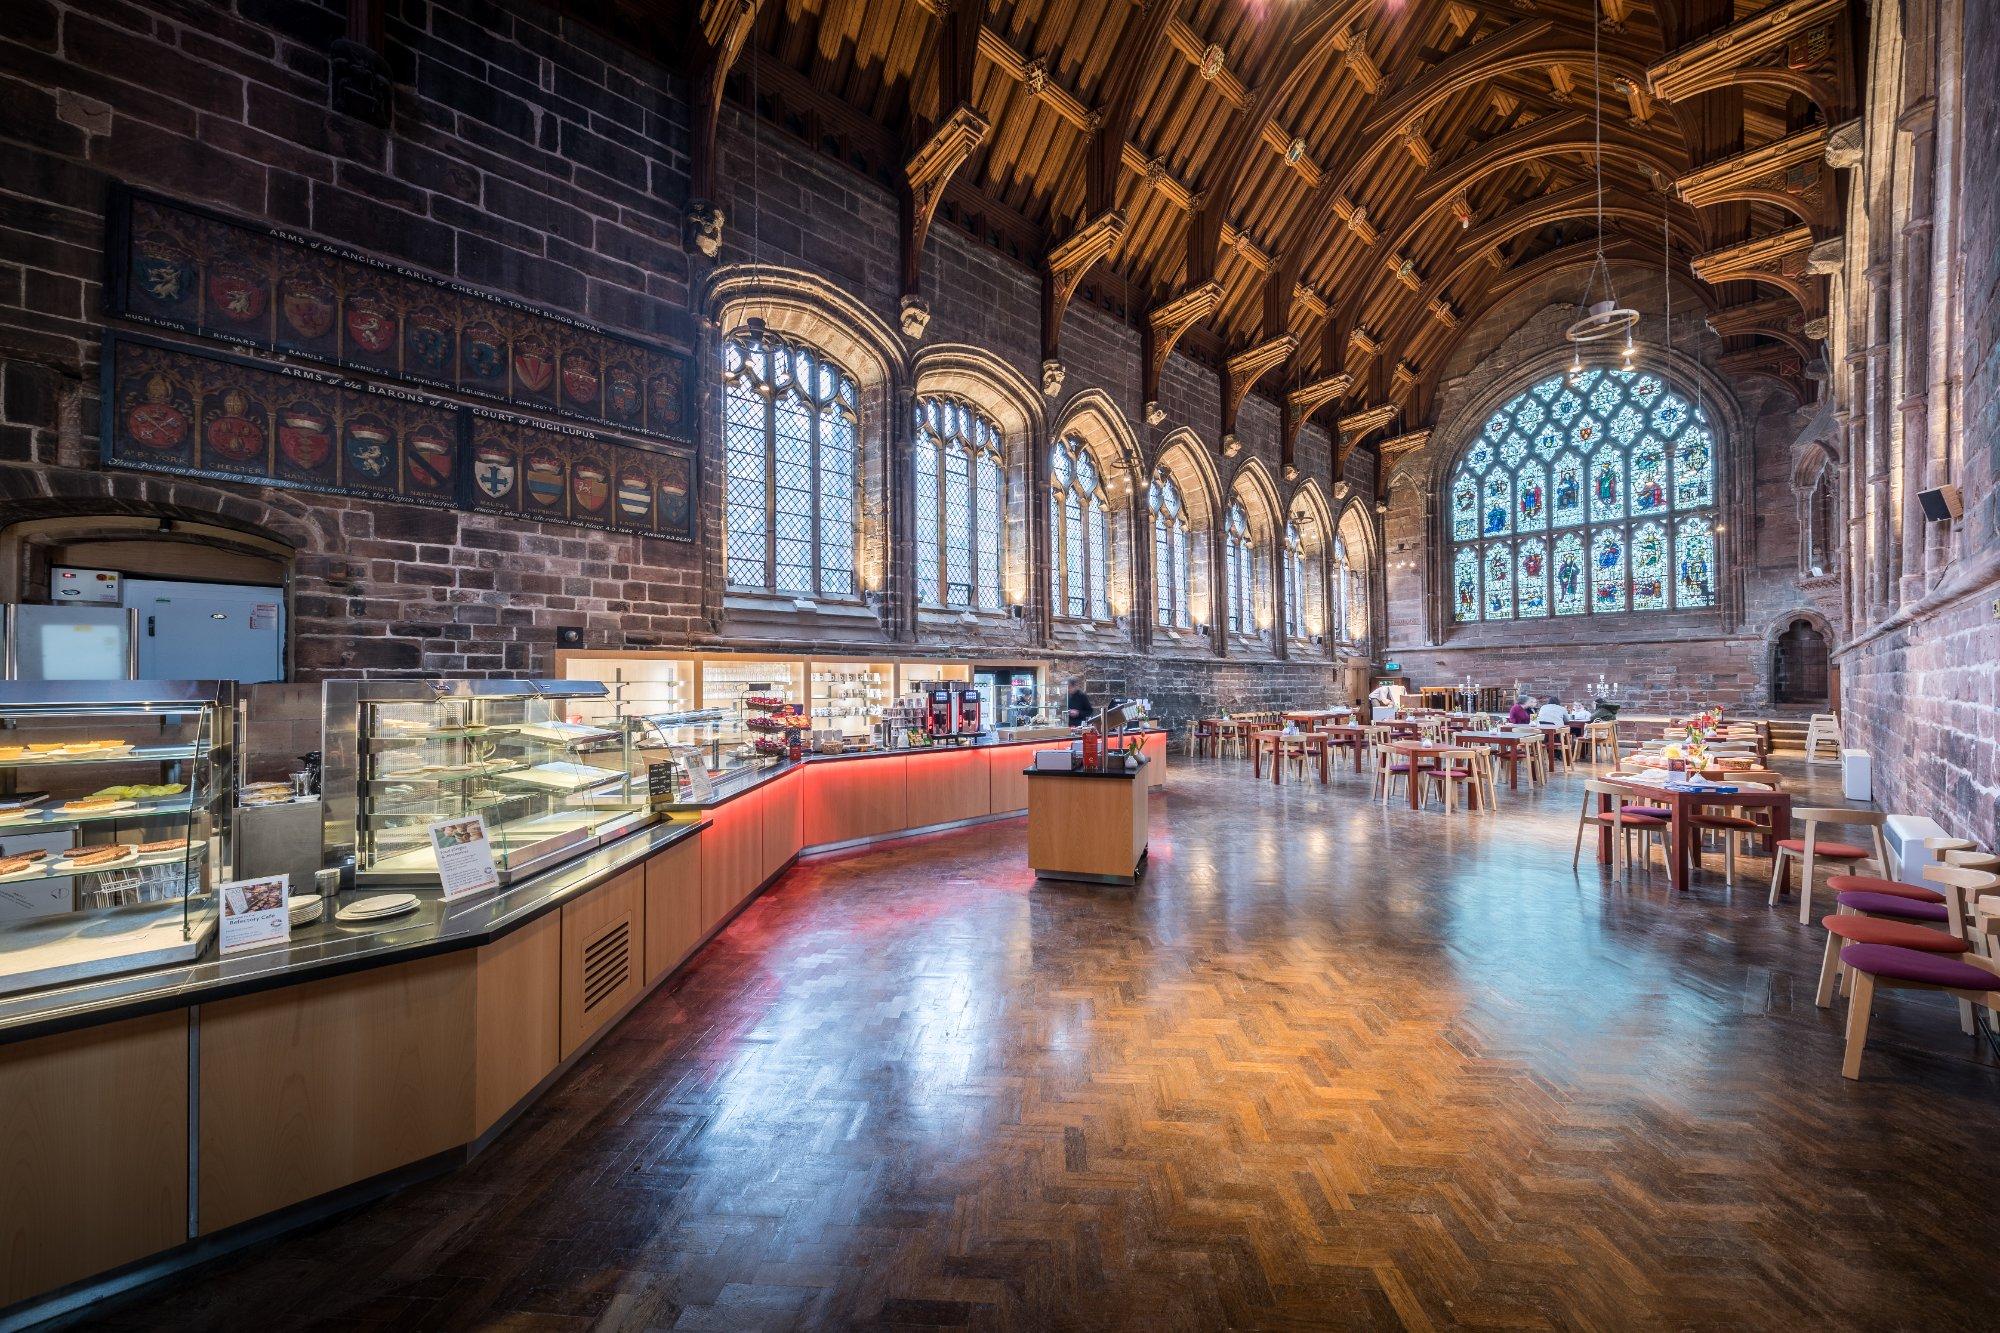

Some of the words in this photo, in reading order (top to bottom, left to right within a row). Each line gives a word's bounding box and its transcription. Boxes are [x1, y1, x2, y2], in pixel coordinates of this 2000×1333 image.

[269, 229, 305, 244] ARMS
[323, 244, 338, 254] the
[341, 250, 392, 269] ANCIENT
[397, 267, 434, 284] EARLS
[508, 300, 522, 309] TO
[524, 305, 541, 316] THE
[543, 311, 572, 324] BLOOD
[125, 312, 150, 323] HUGH
[154, 319, 185, 330] LUPUS
[281, 367, 322, 382] ARMS
[326, 378, 341, 386] of
[344, 381, 362, 391] the
[368, 384, 424, 404] BARONS
[429, 399, 441, 408] of
[444, 402, 460, 412] the
[472, 408, 514, 422] COURT
[532, 420, 560, 432] HUGH
[516, 400, 531, 408] JOHN
[108, 456, 136, 469] These
[138, 461, 186, 475] Paintings
[372, 490, 385, 499] the
